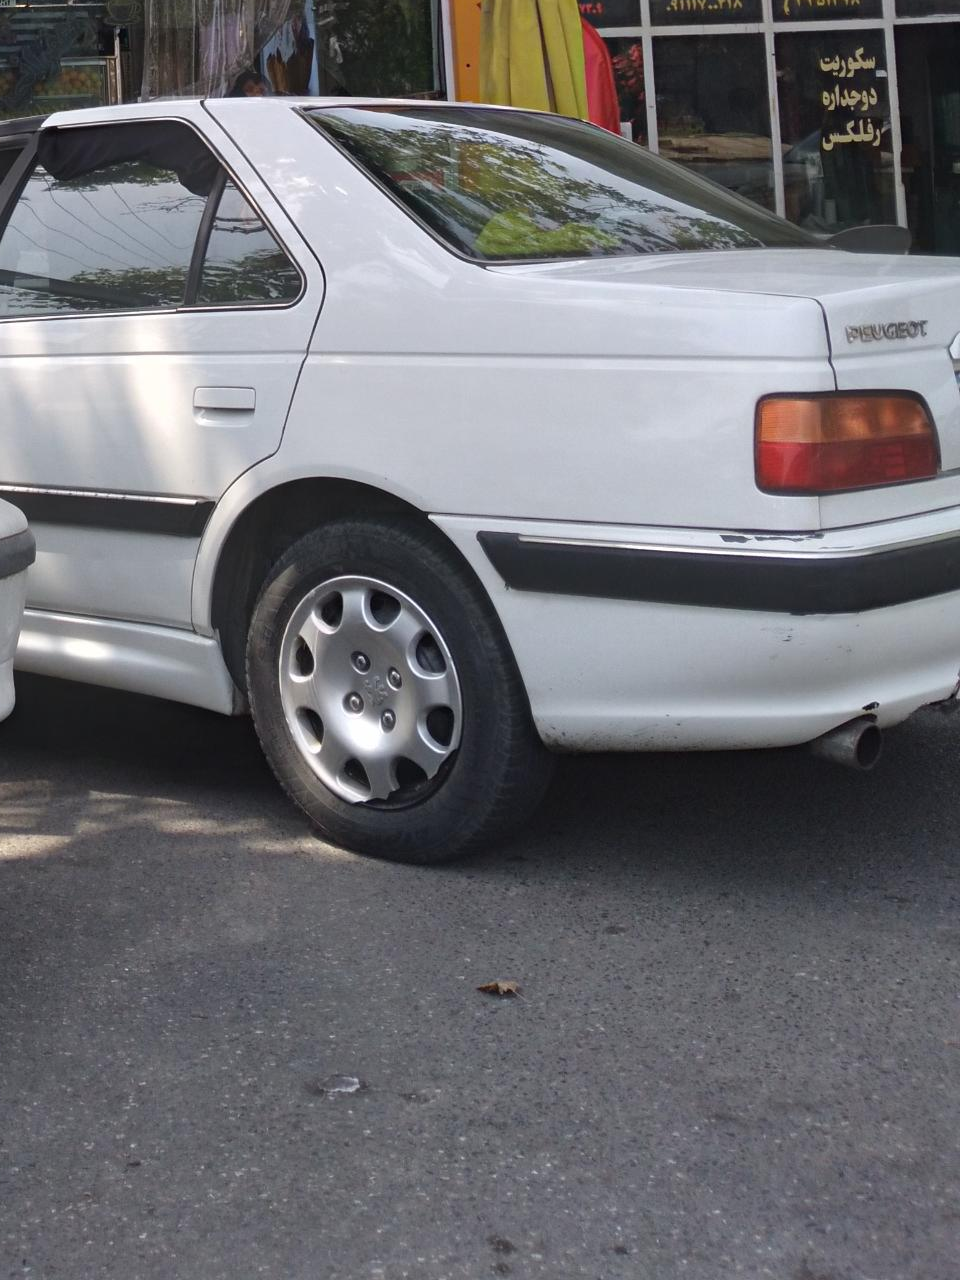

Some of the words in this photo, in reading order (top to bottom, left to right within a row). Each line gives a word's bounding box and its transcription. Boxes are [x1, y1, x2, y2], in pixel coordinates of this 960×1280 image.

[819, 47, 876, 77] سکوریت
[821, 117, 881, 151] رفلکس
[845, 320, 928, 344] PEUGEOT
